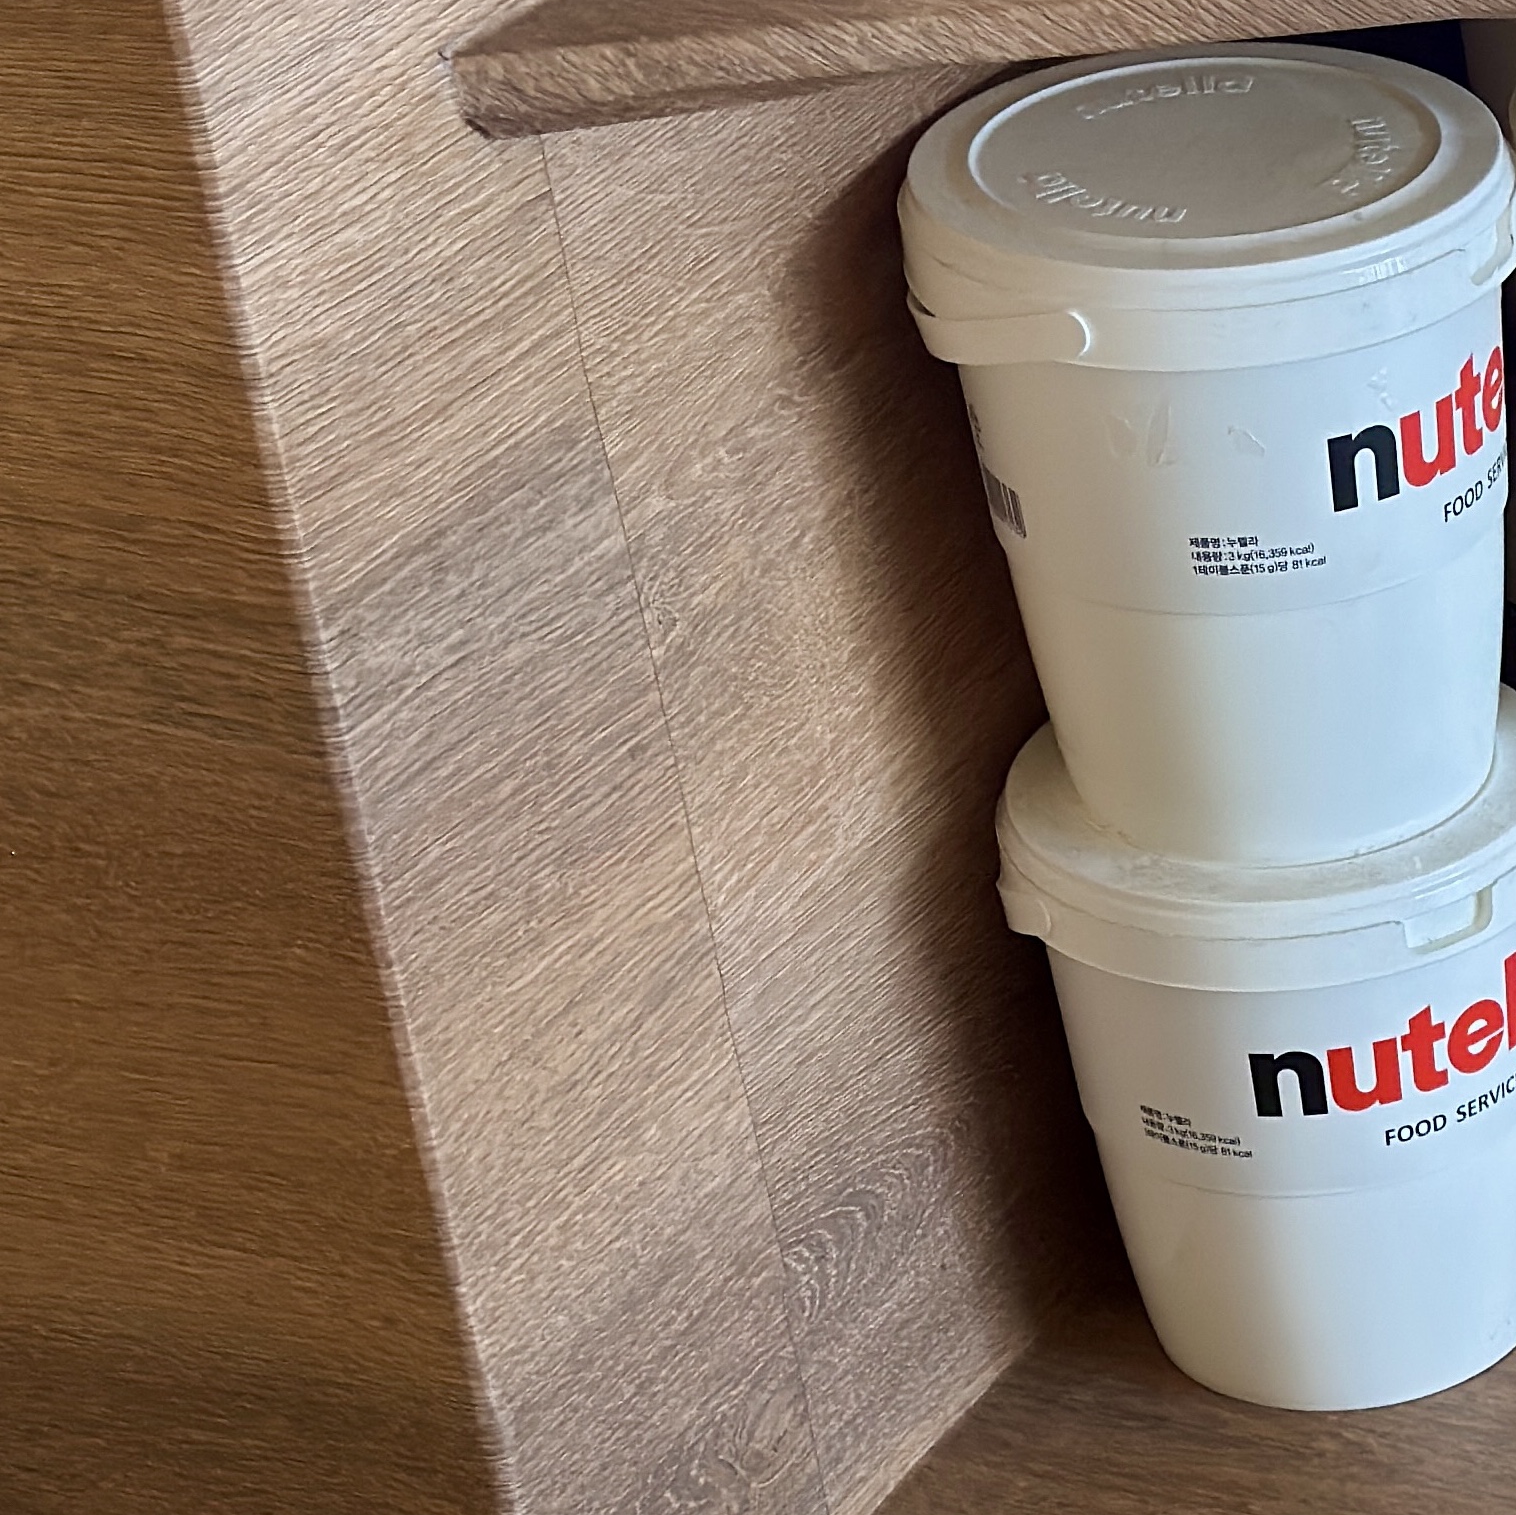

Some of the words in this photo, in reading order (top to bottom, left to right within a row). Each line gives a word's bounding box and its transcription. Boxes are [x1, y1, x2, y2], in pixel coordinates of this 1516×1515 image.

[1327, 346, 1504, 513] nute
[1444, 479, 1483, 523] FOOD
[1385, 1114, 1447, 1147] FOOD
